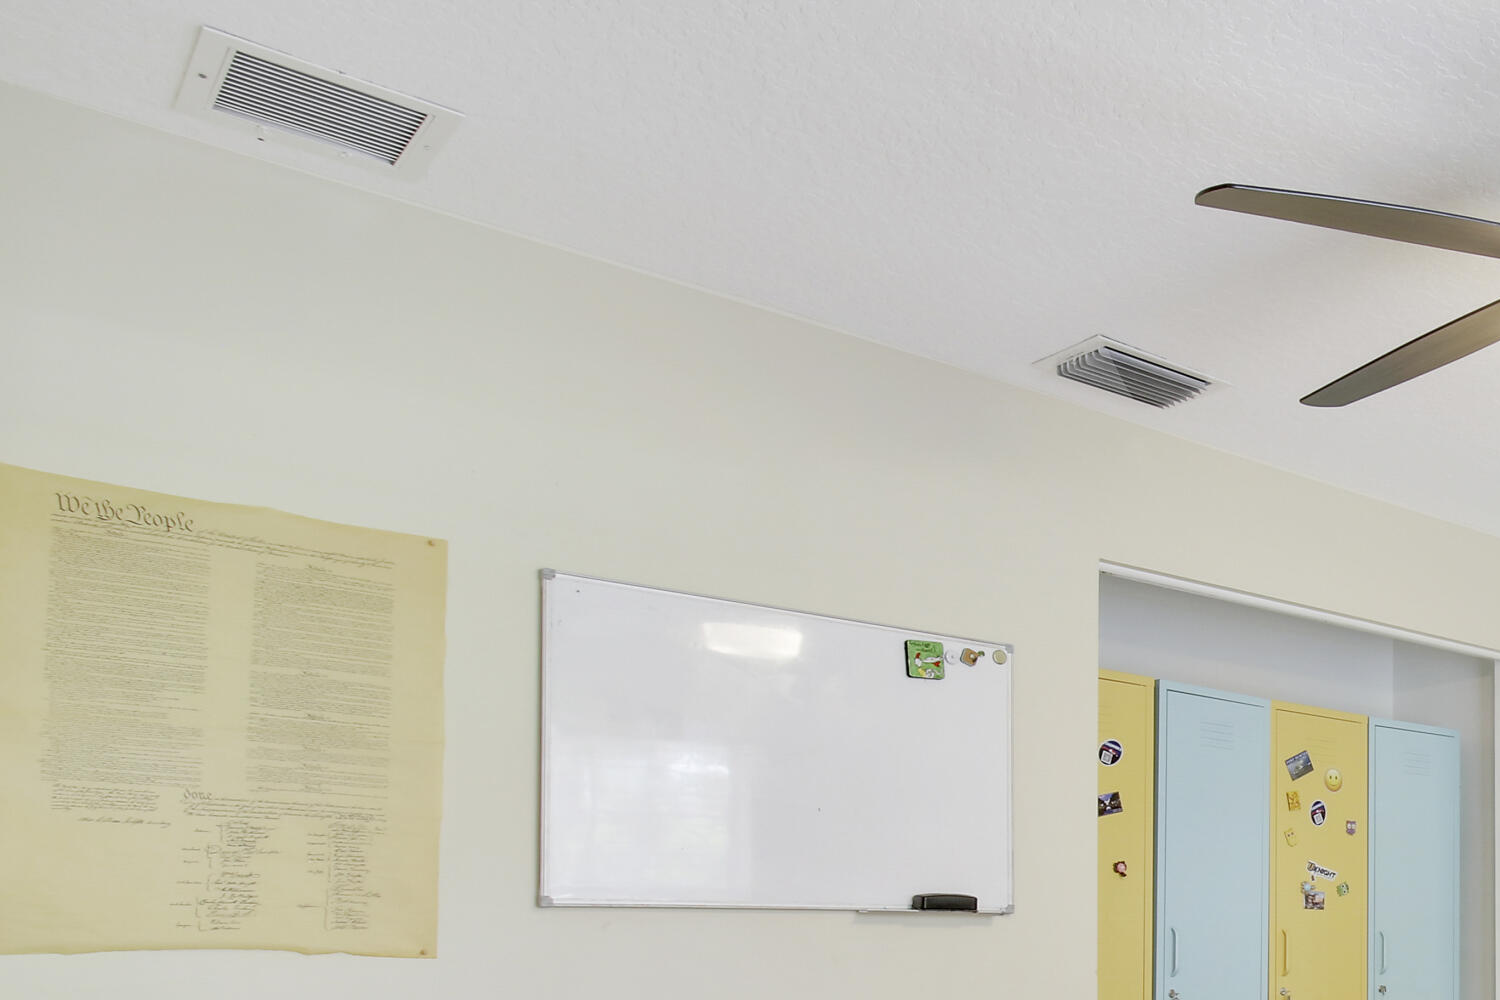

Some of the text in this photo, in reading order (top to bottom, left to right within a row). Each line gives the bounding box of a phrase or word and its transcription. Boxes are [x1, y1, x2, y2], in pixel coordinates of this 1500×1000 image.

[54, 491, 194, 532] We the People
